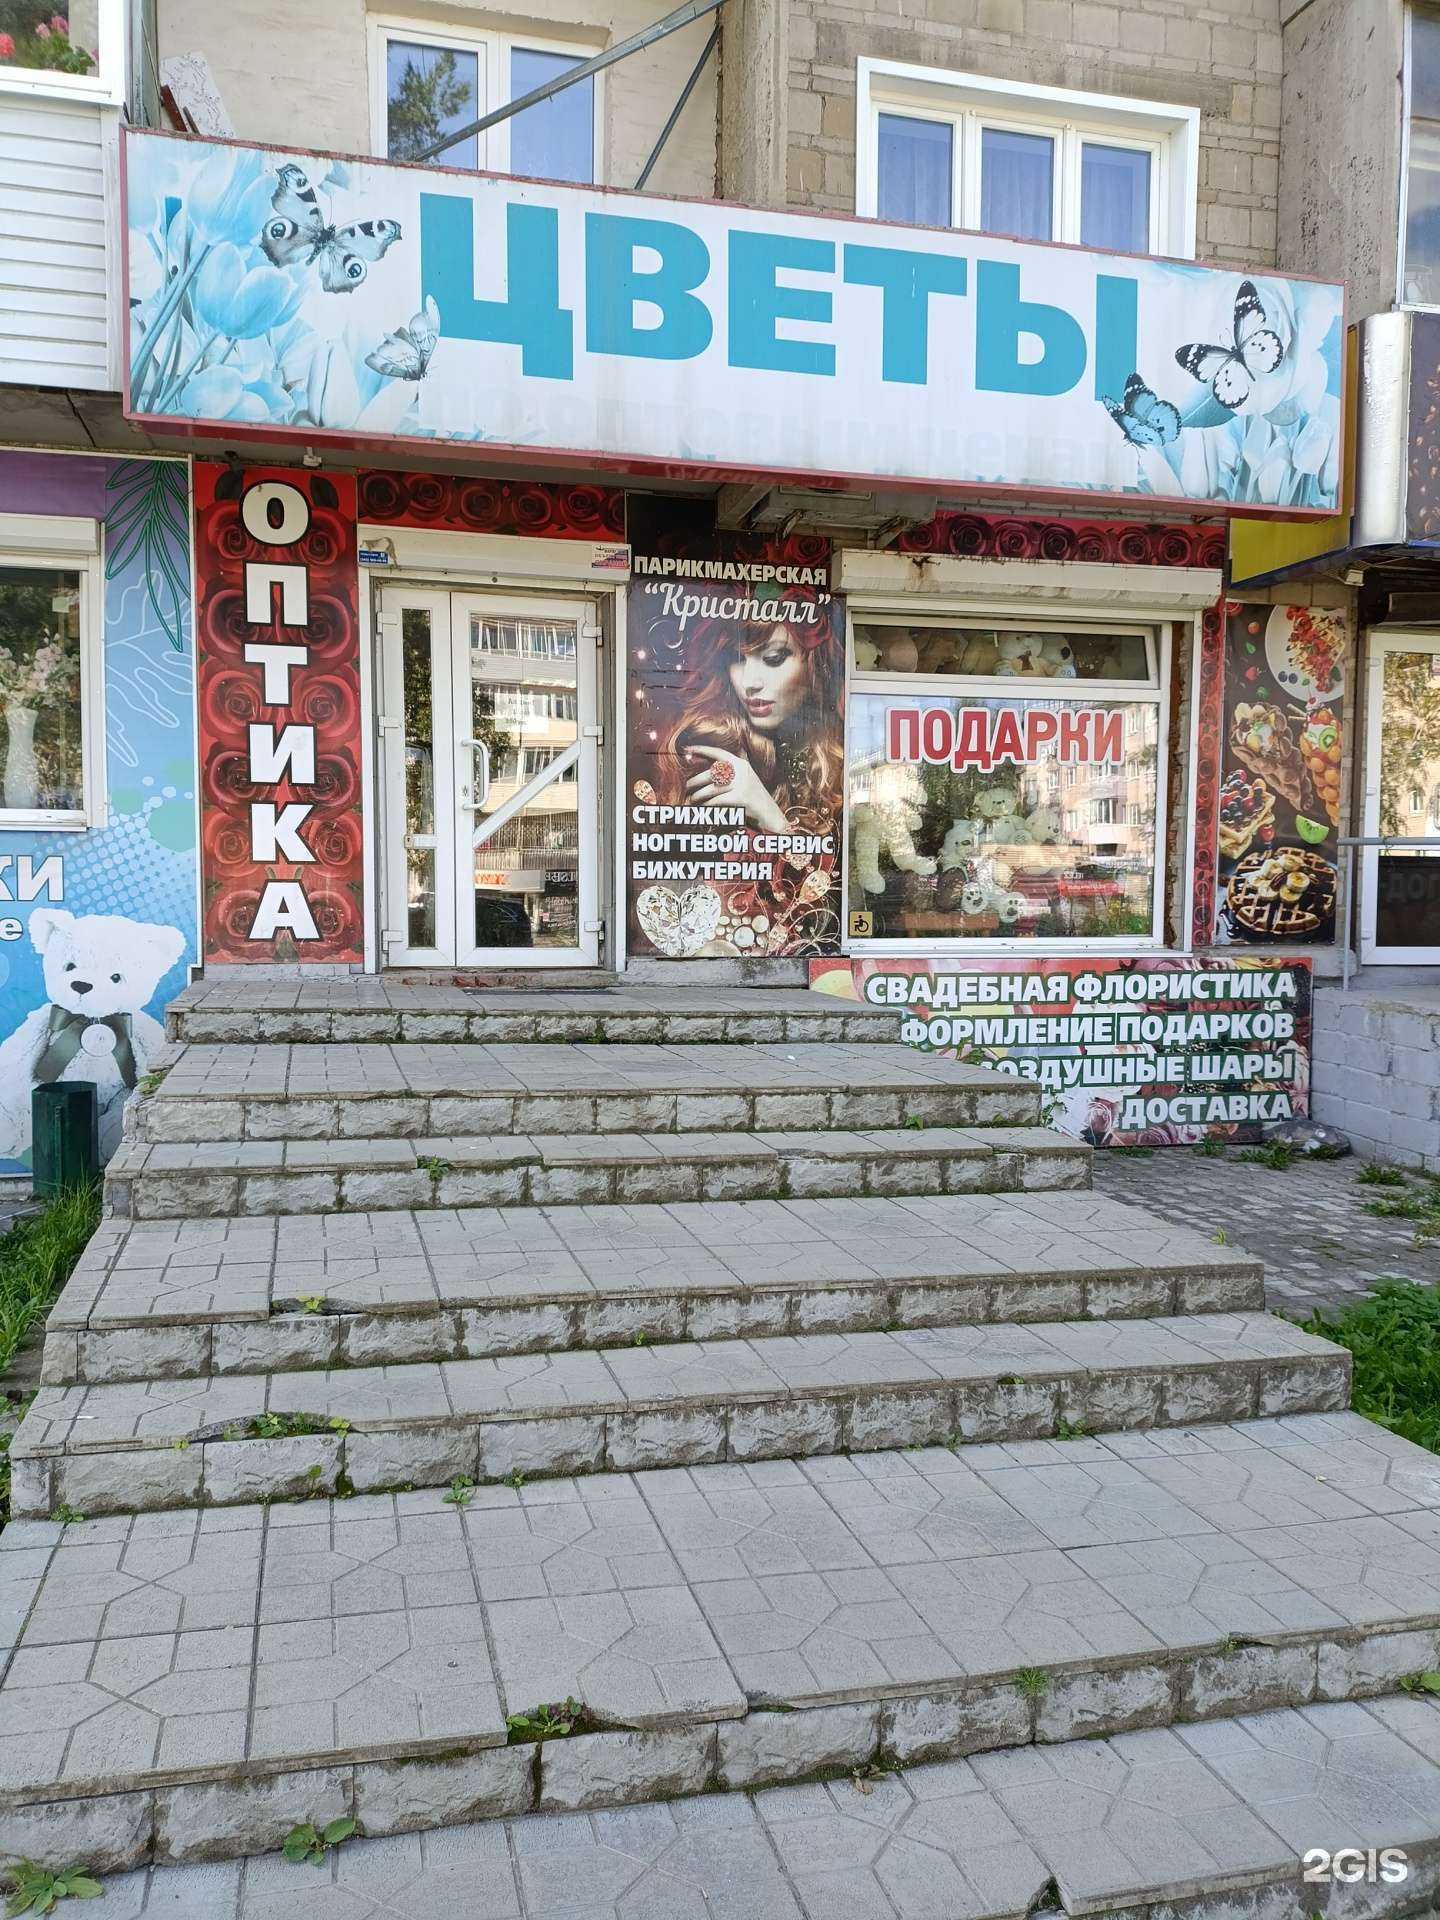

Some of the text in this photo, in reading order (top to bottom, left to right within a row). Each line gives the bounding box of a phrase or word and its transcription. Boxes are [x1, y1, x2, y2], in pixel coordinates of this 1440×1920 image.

[420, 192, 1139, 401] ЦВЕТЫ
[634, 556, 827, 585] ПАРИКМАХЕРСКАЯ
[243, 481, 319, 942] ОПТИКА
[888, 708, 1123, 771] ПОДАРКИ
[632, 805, 745, 825] СТРИЖКИ
[632, 828, 834, 855] НОГТЕВОЙ СЕРВИС
[632, 861, 773, 880] БИЖУТЕРИЯ
[866, 971, 1296, 1008] СВАДЕБНАЯ ФЛОРИСТИКА
[1119, 1013, 1294, 1046] ПОДАРКОВ
[980, 1053, 1293, 1092] ОЗДУШНЫЕ ШАРЫ
[1121, 1094, 1292, 1129] ДОСТАВКА
